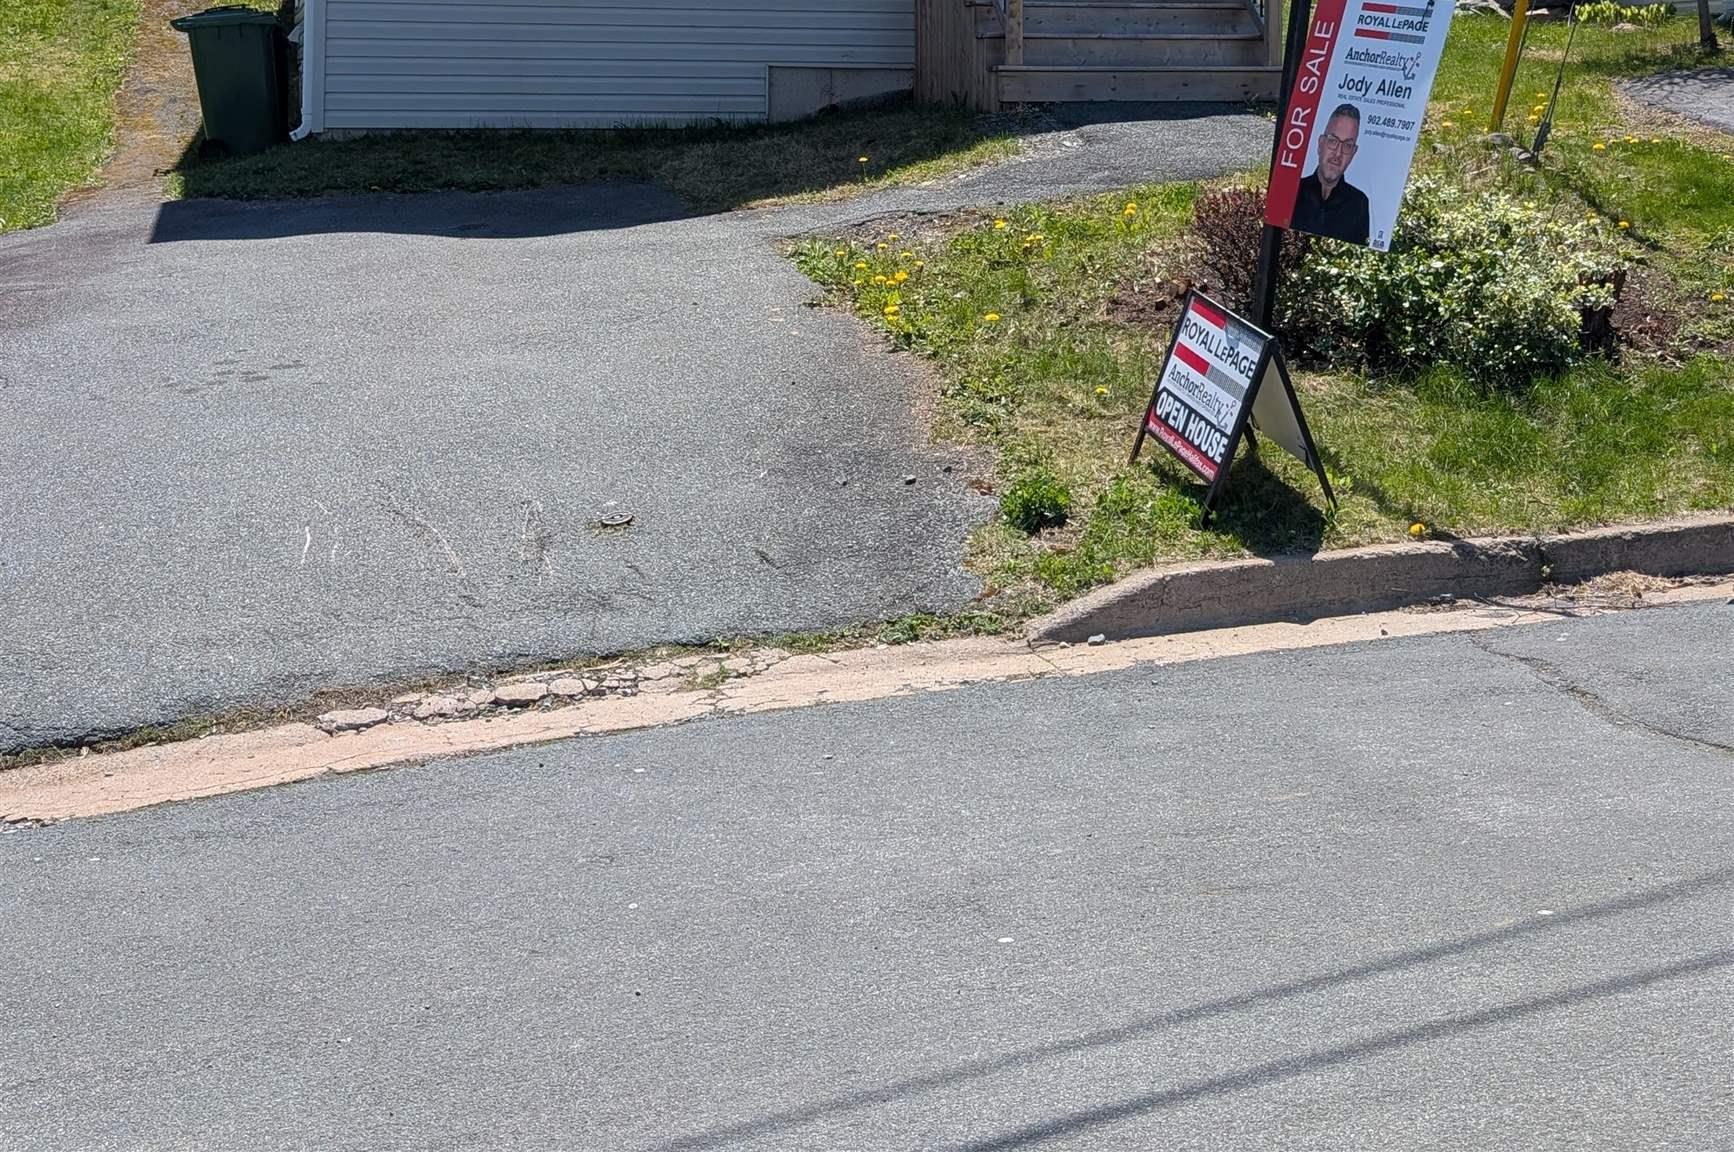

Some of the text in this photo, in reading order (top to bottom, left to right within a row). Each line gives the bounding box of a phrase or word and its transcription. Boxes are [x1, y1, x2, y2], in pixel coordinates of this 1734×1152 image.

[1281, 19, 1335, 168] FOR SALE
[1338, 73, 1412, 100] Jody Allen
[1367, 114, 1416, 131] 902.489.7907
[1155, 391, 1189, 432] OPEN
[1187, 415, 1229, 464] HOUSE
